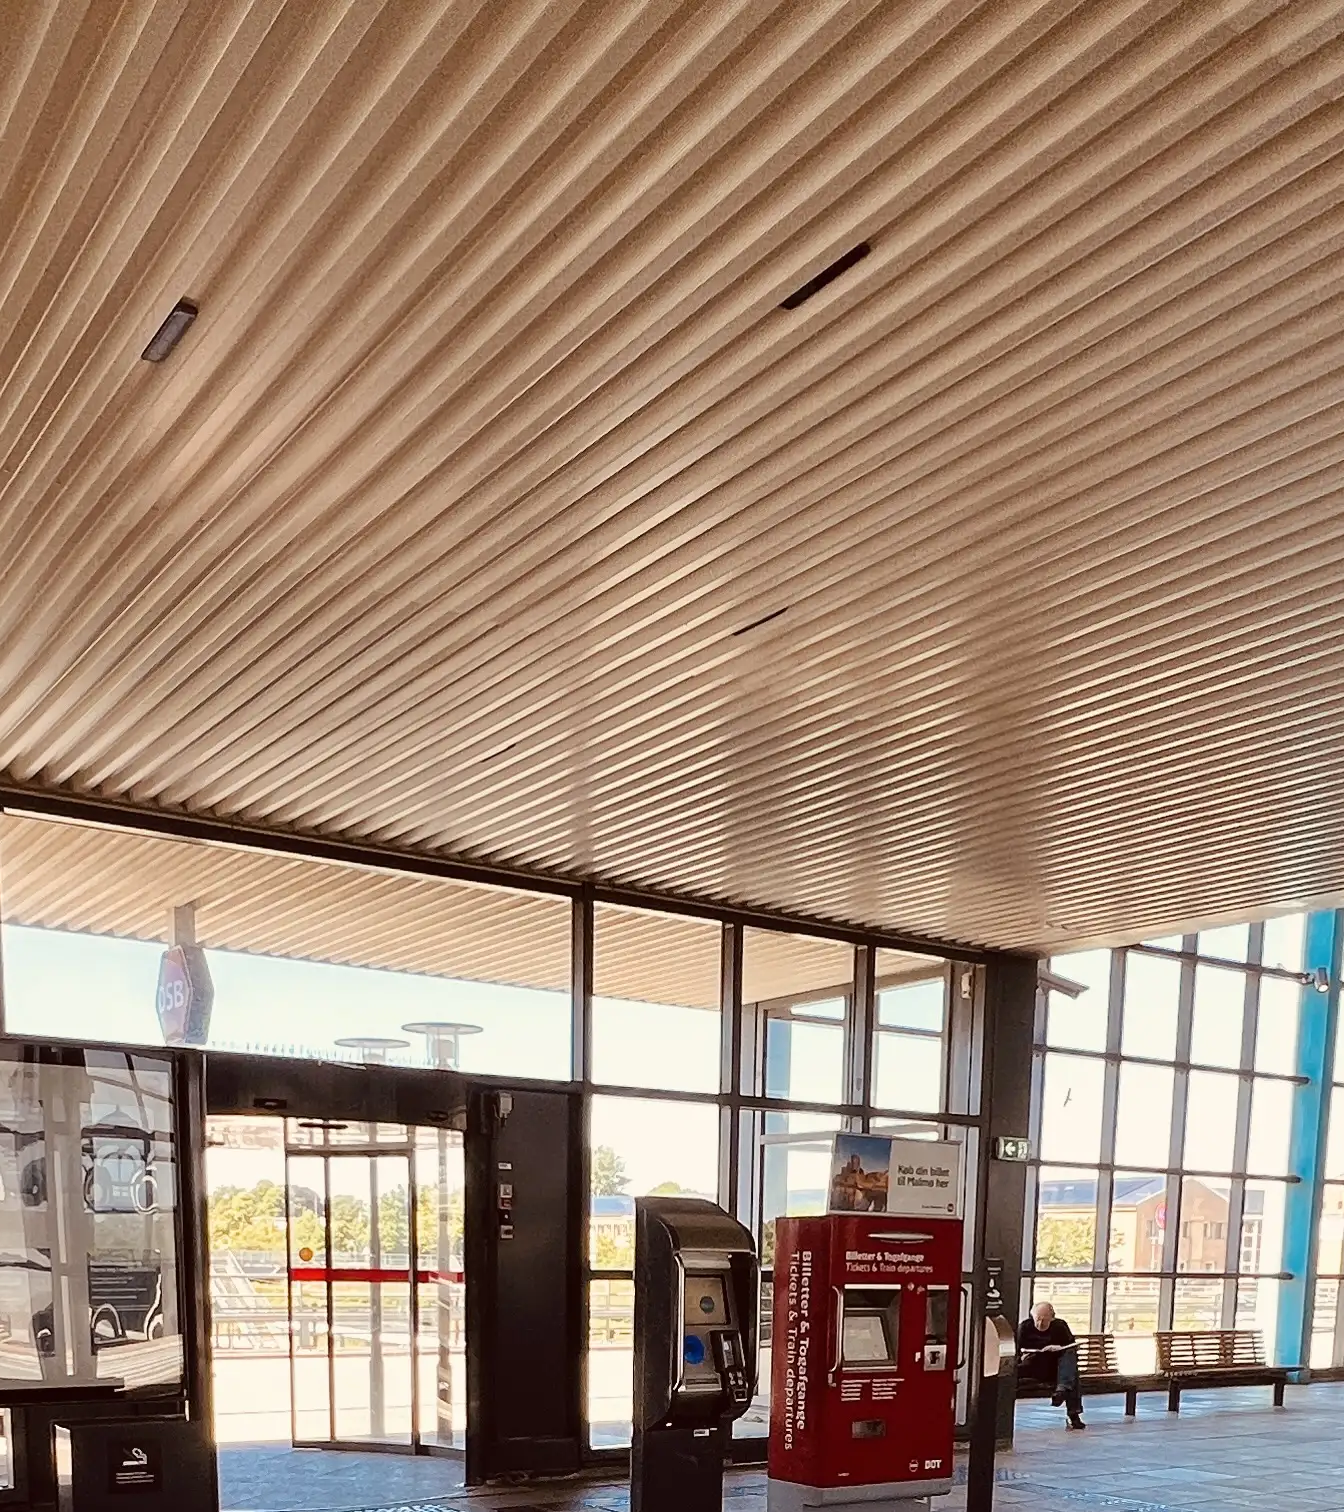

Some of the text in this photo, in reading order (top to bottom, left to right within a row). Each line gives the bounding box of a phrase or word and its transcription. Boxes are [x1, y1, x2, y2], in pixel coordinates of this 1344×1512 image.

[157, 979, 185, 1015] DSB
[845, 1250, 876, 1261] Billetter
[876, 1251, 882, 1261] &
[845, 1262, 934, 1274] Tickets & Train departures
[784, 1250, 800, 1450] Tickets & Train departures
[795, 1250, 812, 1430] Billetter & Togafgange
[924, 1459, 942, 1470] DOT
